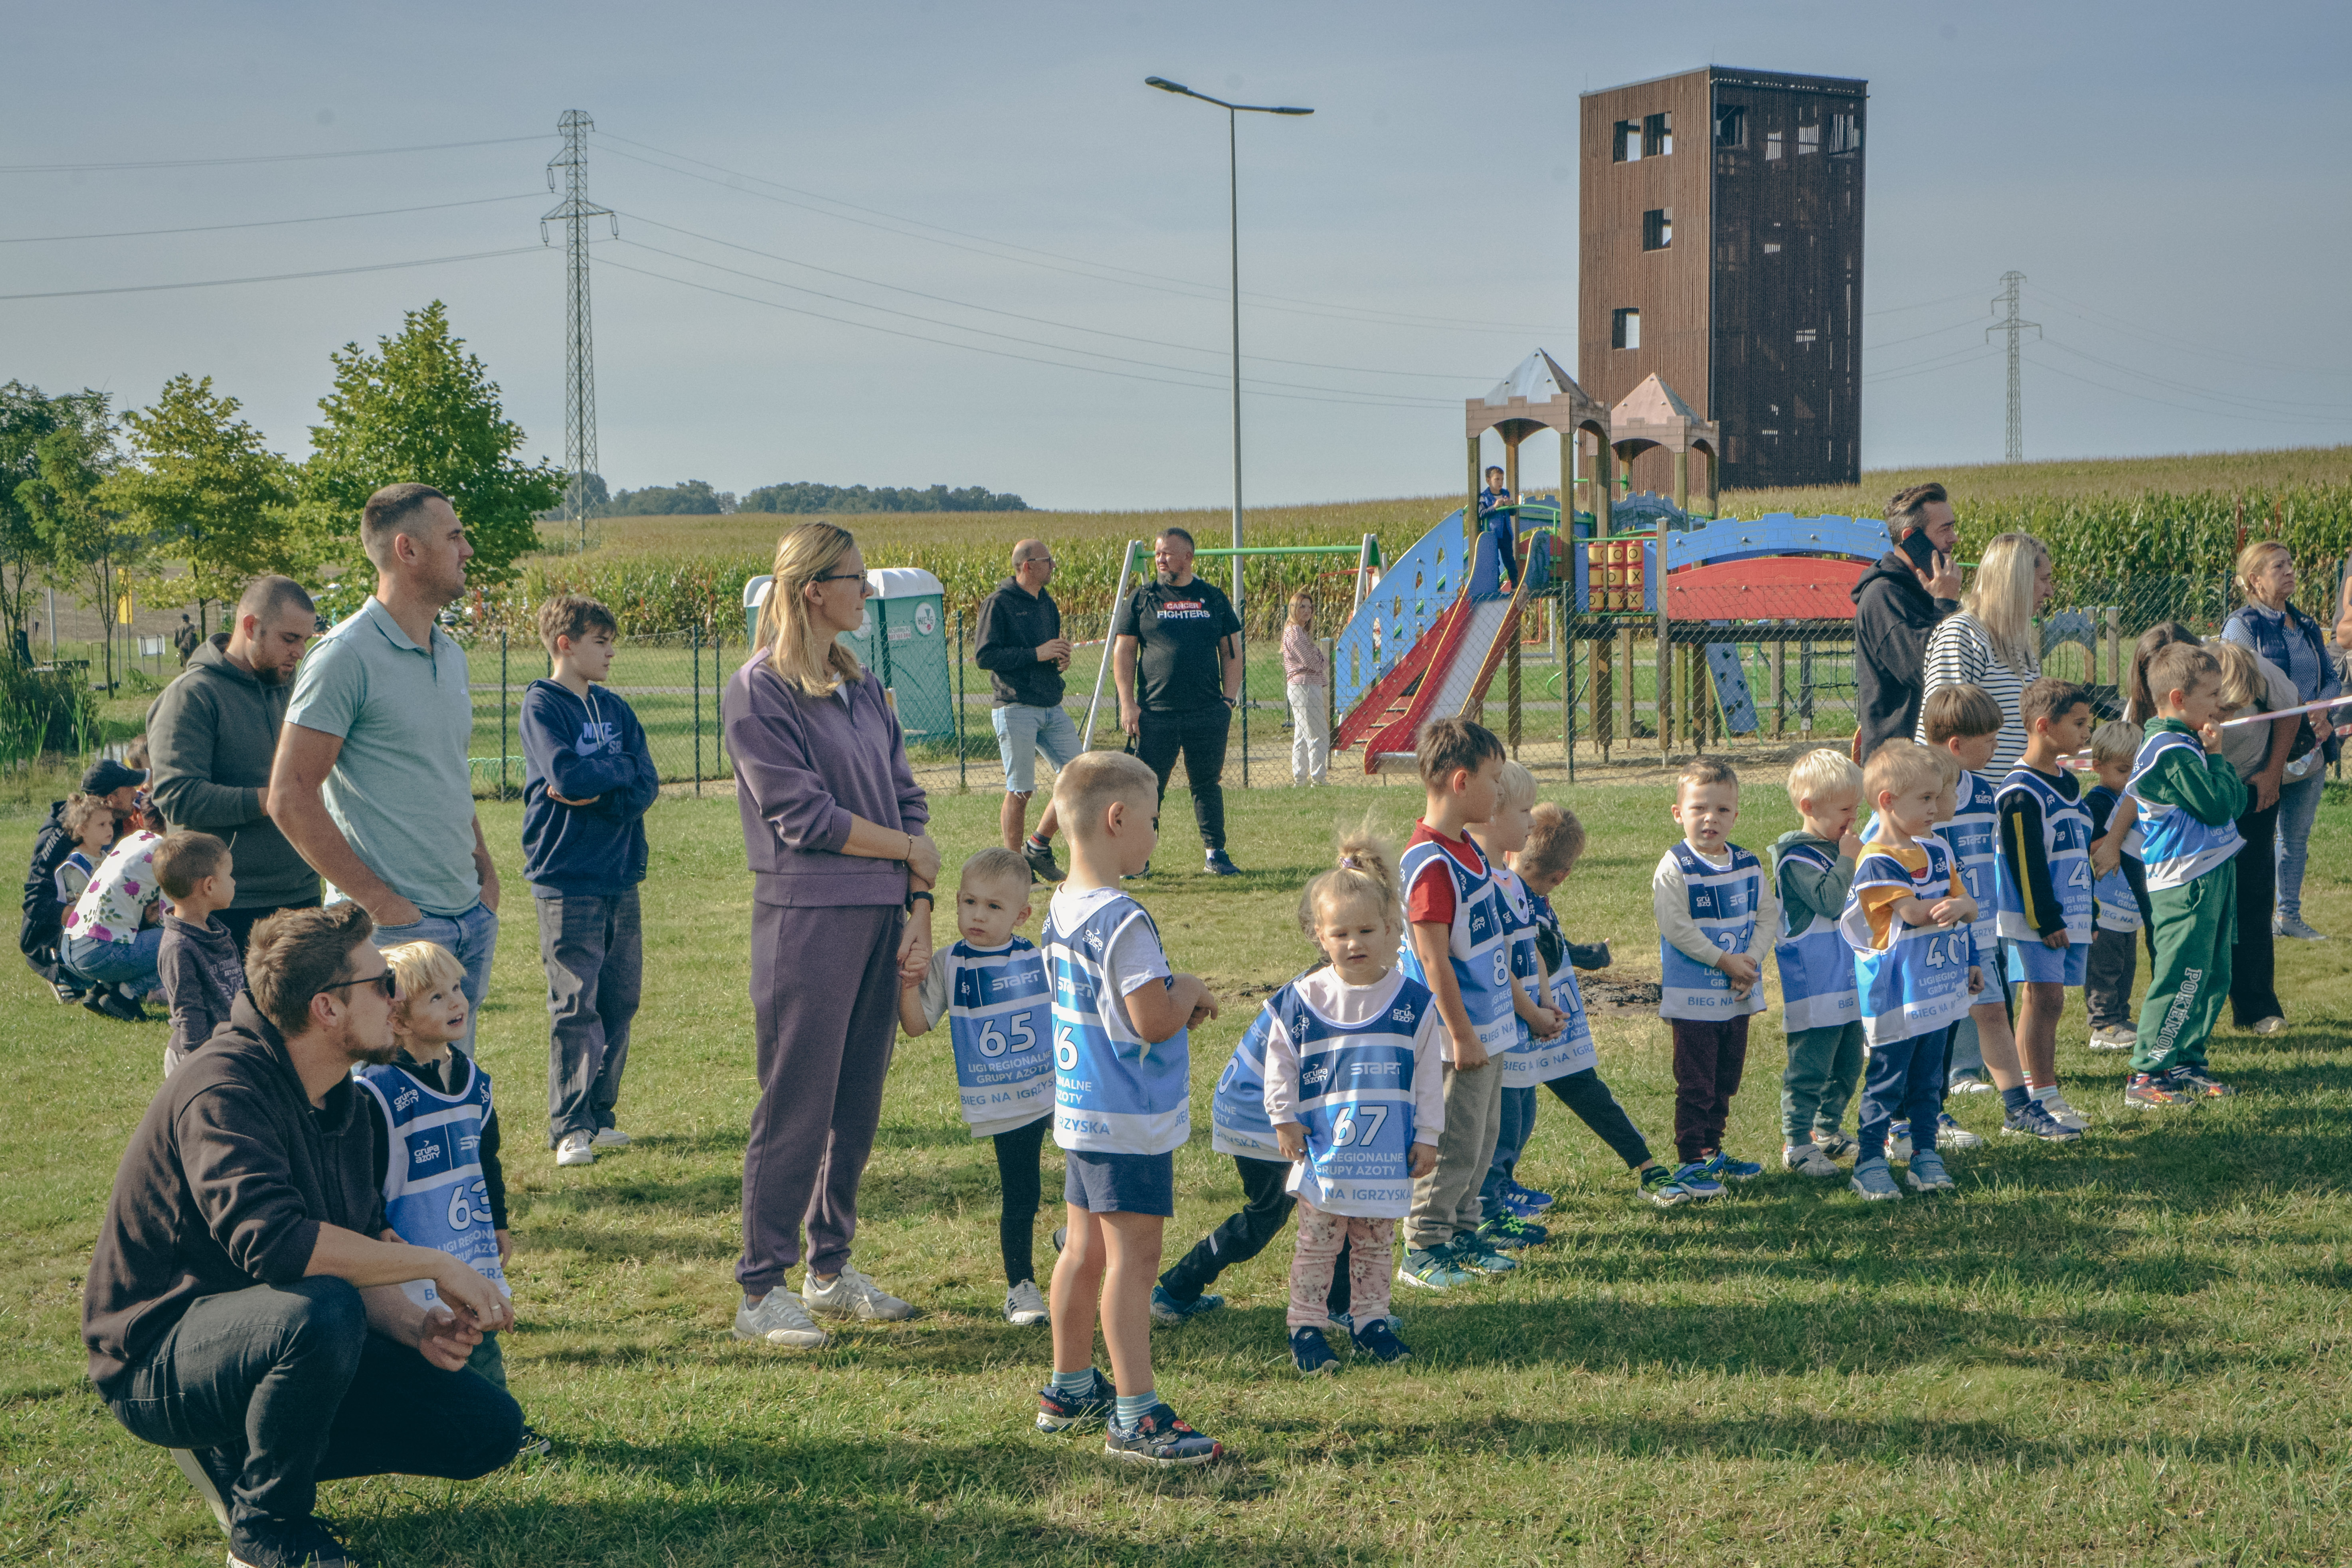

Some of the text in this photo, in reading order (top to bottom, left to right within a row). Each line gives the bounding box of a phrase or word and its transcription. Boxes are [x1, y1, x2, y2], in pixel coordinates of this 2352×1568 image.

[1157, 609, 1211, 619] FIGHTERS
[583, 722, 611, 739] NIKE
[608, 740, 622, 754] SB
[2115, 889, 2129, 900] LIGI
[2120, 915, 2133, 924] NA
[1687, 997, 1733, 1006] BIEG NA
[1911, 1006, 1937, 1020] BIEG
[2148, 967, 2202, 1063] POKÉMON
[979, 1010, 1037, 1058] 65
[1480, 1022, 1515, 1043] BIEG NA
[968, 1050, 1053, 1073] LIGI REGIONALNE
[1553, 1052, 1569, 1064] NA
[977, 1062, 1050, 1084] GRUPY AZOTY
[960, 1095, 986, 1106] BIEG
[991, 1092, 1011, 1103] NA
[1331, 1104, 1389, 1147] 67
[1315, 1164, 1397, 1175] GRUPY AZOTY
[1324, 1187, 1345, 1200] NA
[1352, 1188, 1411, 1200] IGRZYSKA
[447, 1179, 493, 1232] 63
